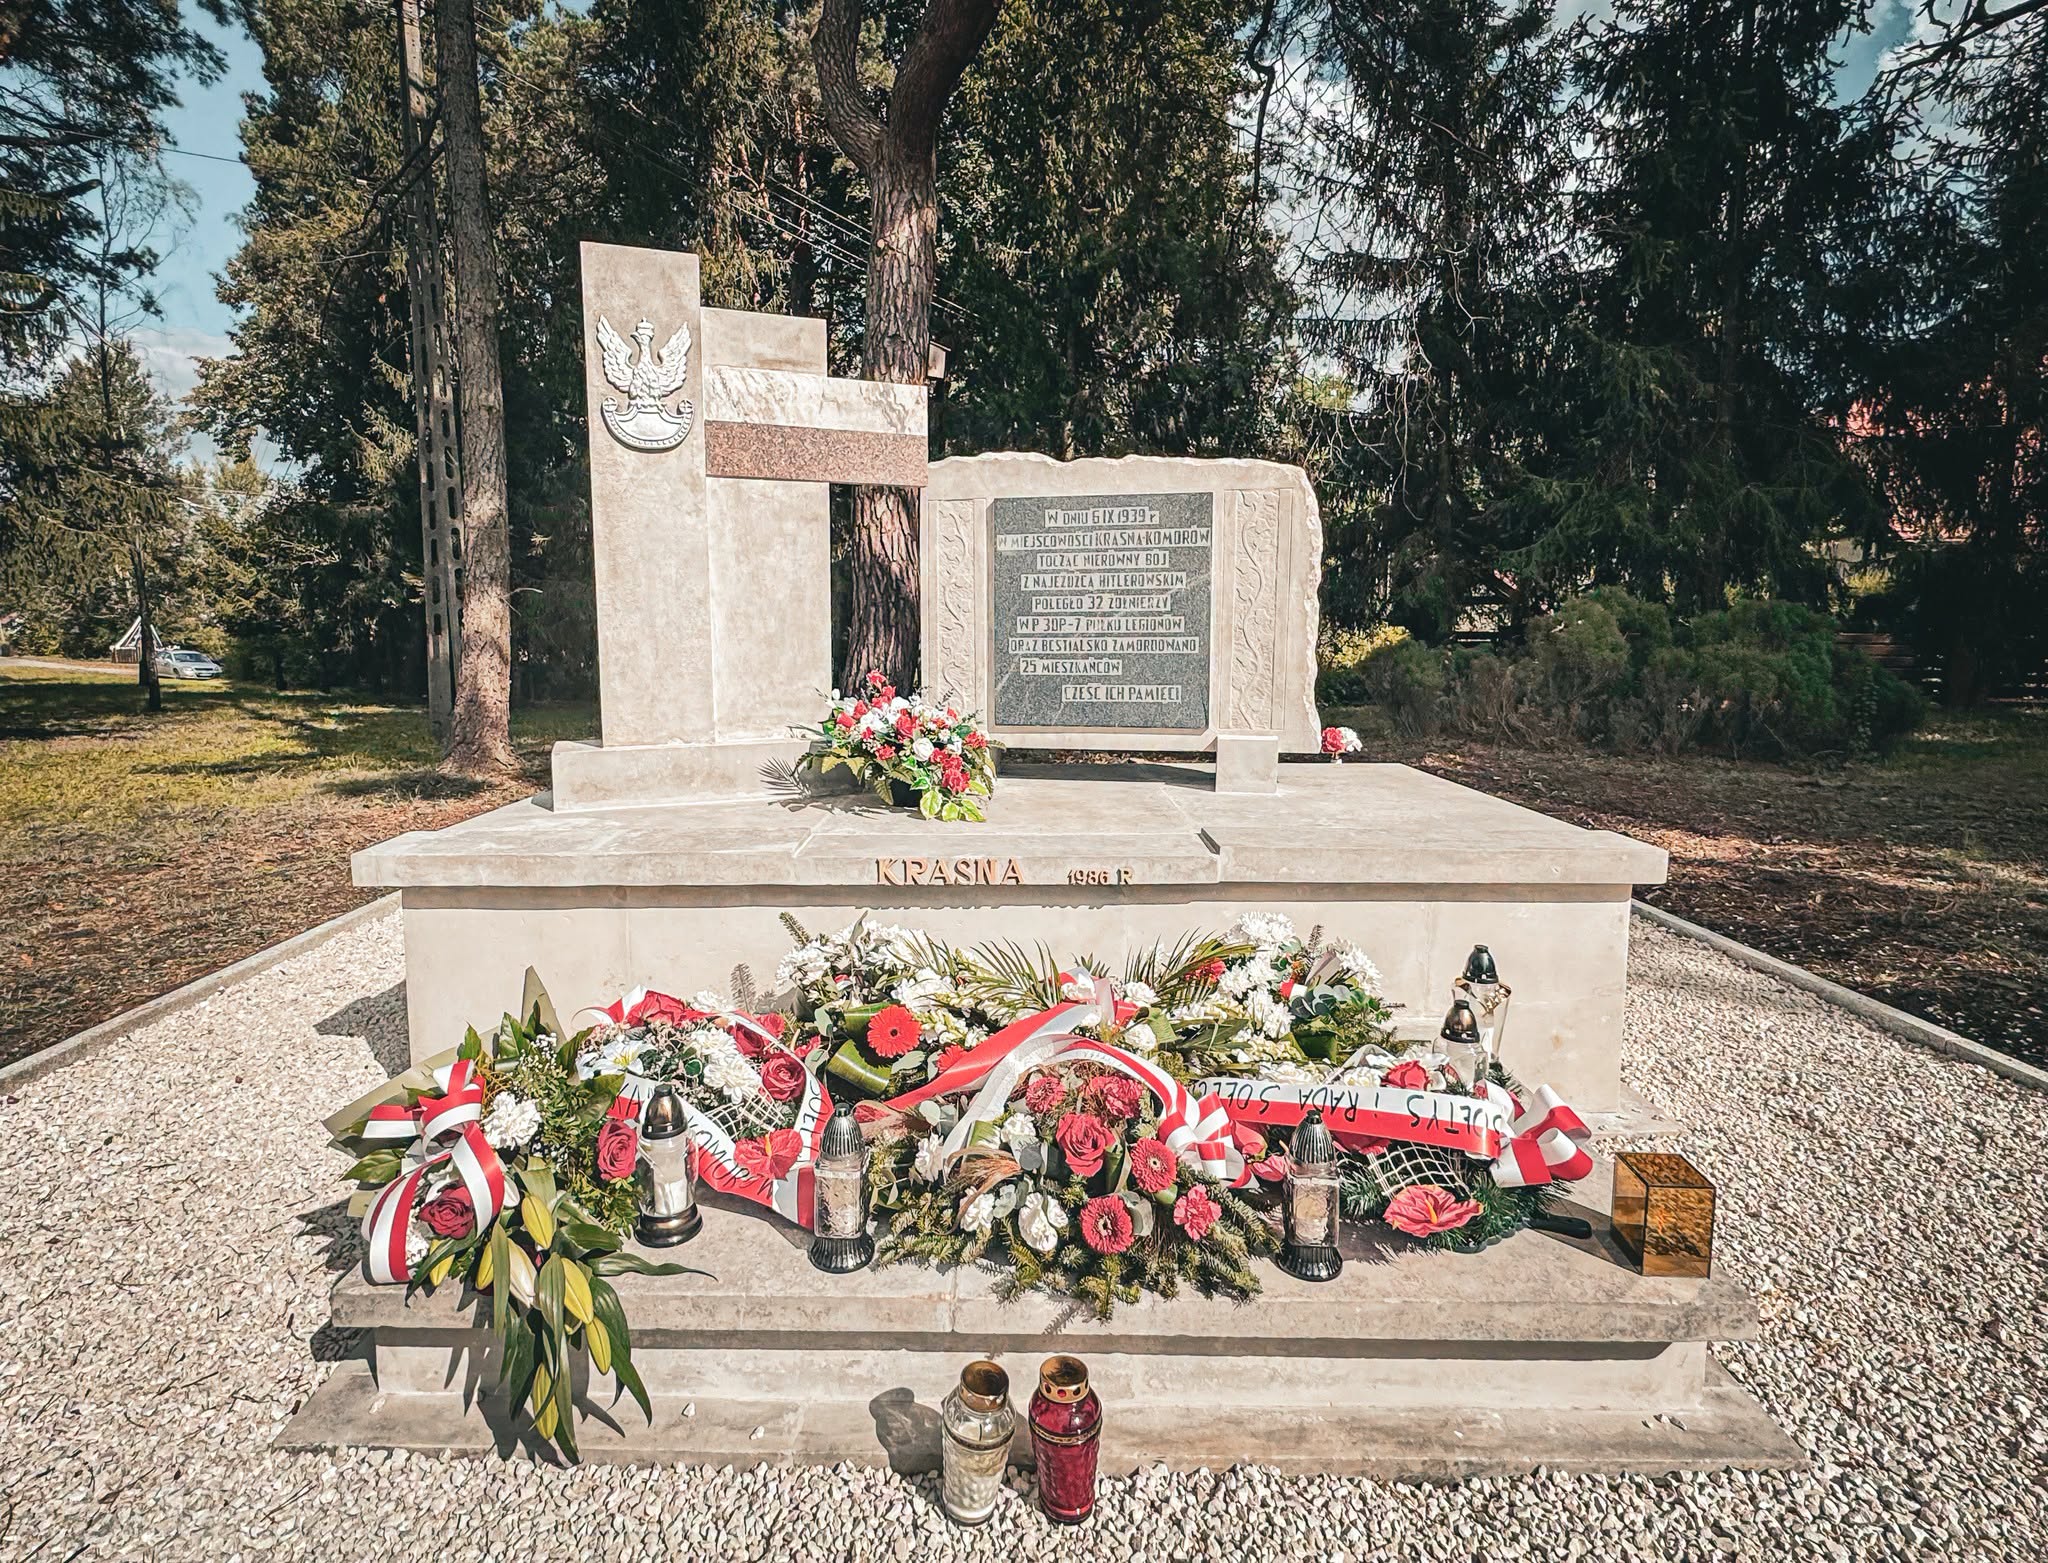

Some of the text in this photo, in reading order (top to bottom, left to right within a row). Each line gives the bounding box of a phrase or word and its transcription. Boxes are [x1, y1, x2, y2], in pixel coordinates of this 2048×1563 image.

[1047, 511, 1058, 523] W
[1063, 512, 1089, 525] DNIU
[1092, 510, 1100, 524] 6
[1103, 509, 1114, 524] IX
[1118, 508, 1146, 523] 1939
[1023, 576, 1029, 588] Z
[1099, 573, 1184, 588] HITLEROWSKIM
[1087, 596, 1103, 610] 32
[1010, 639, 1038, 652] ORAZ
[1112, 639, 1196, 652] ZAMORDOWANO
[1021, 660, 1037, 673] 25
[1105, 686, 1125, 701] ICH
[875, 857, 1136, 886] KRASNA 1986 R
[1298, 1086, 1359, 1123] RADA
